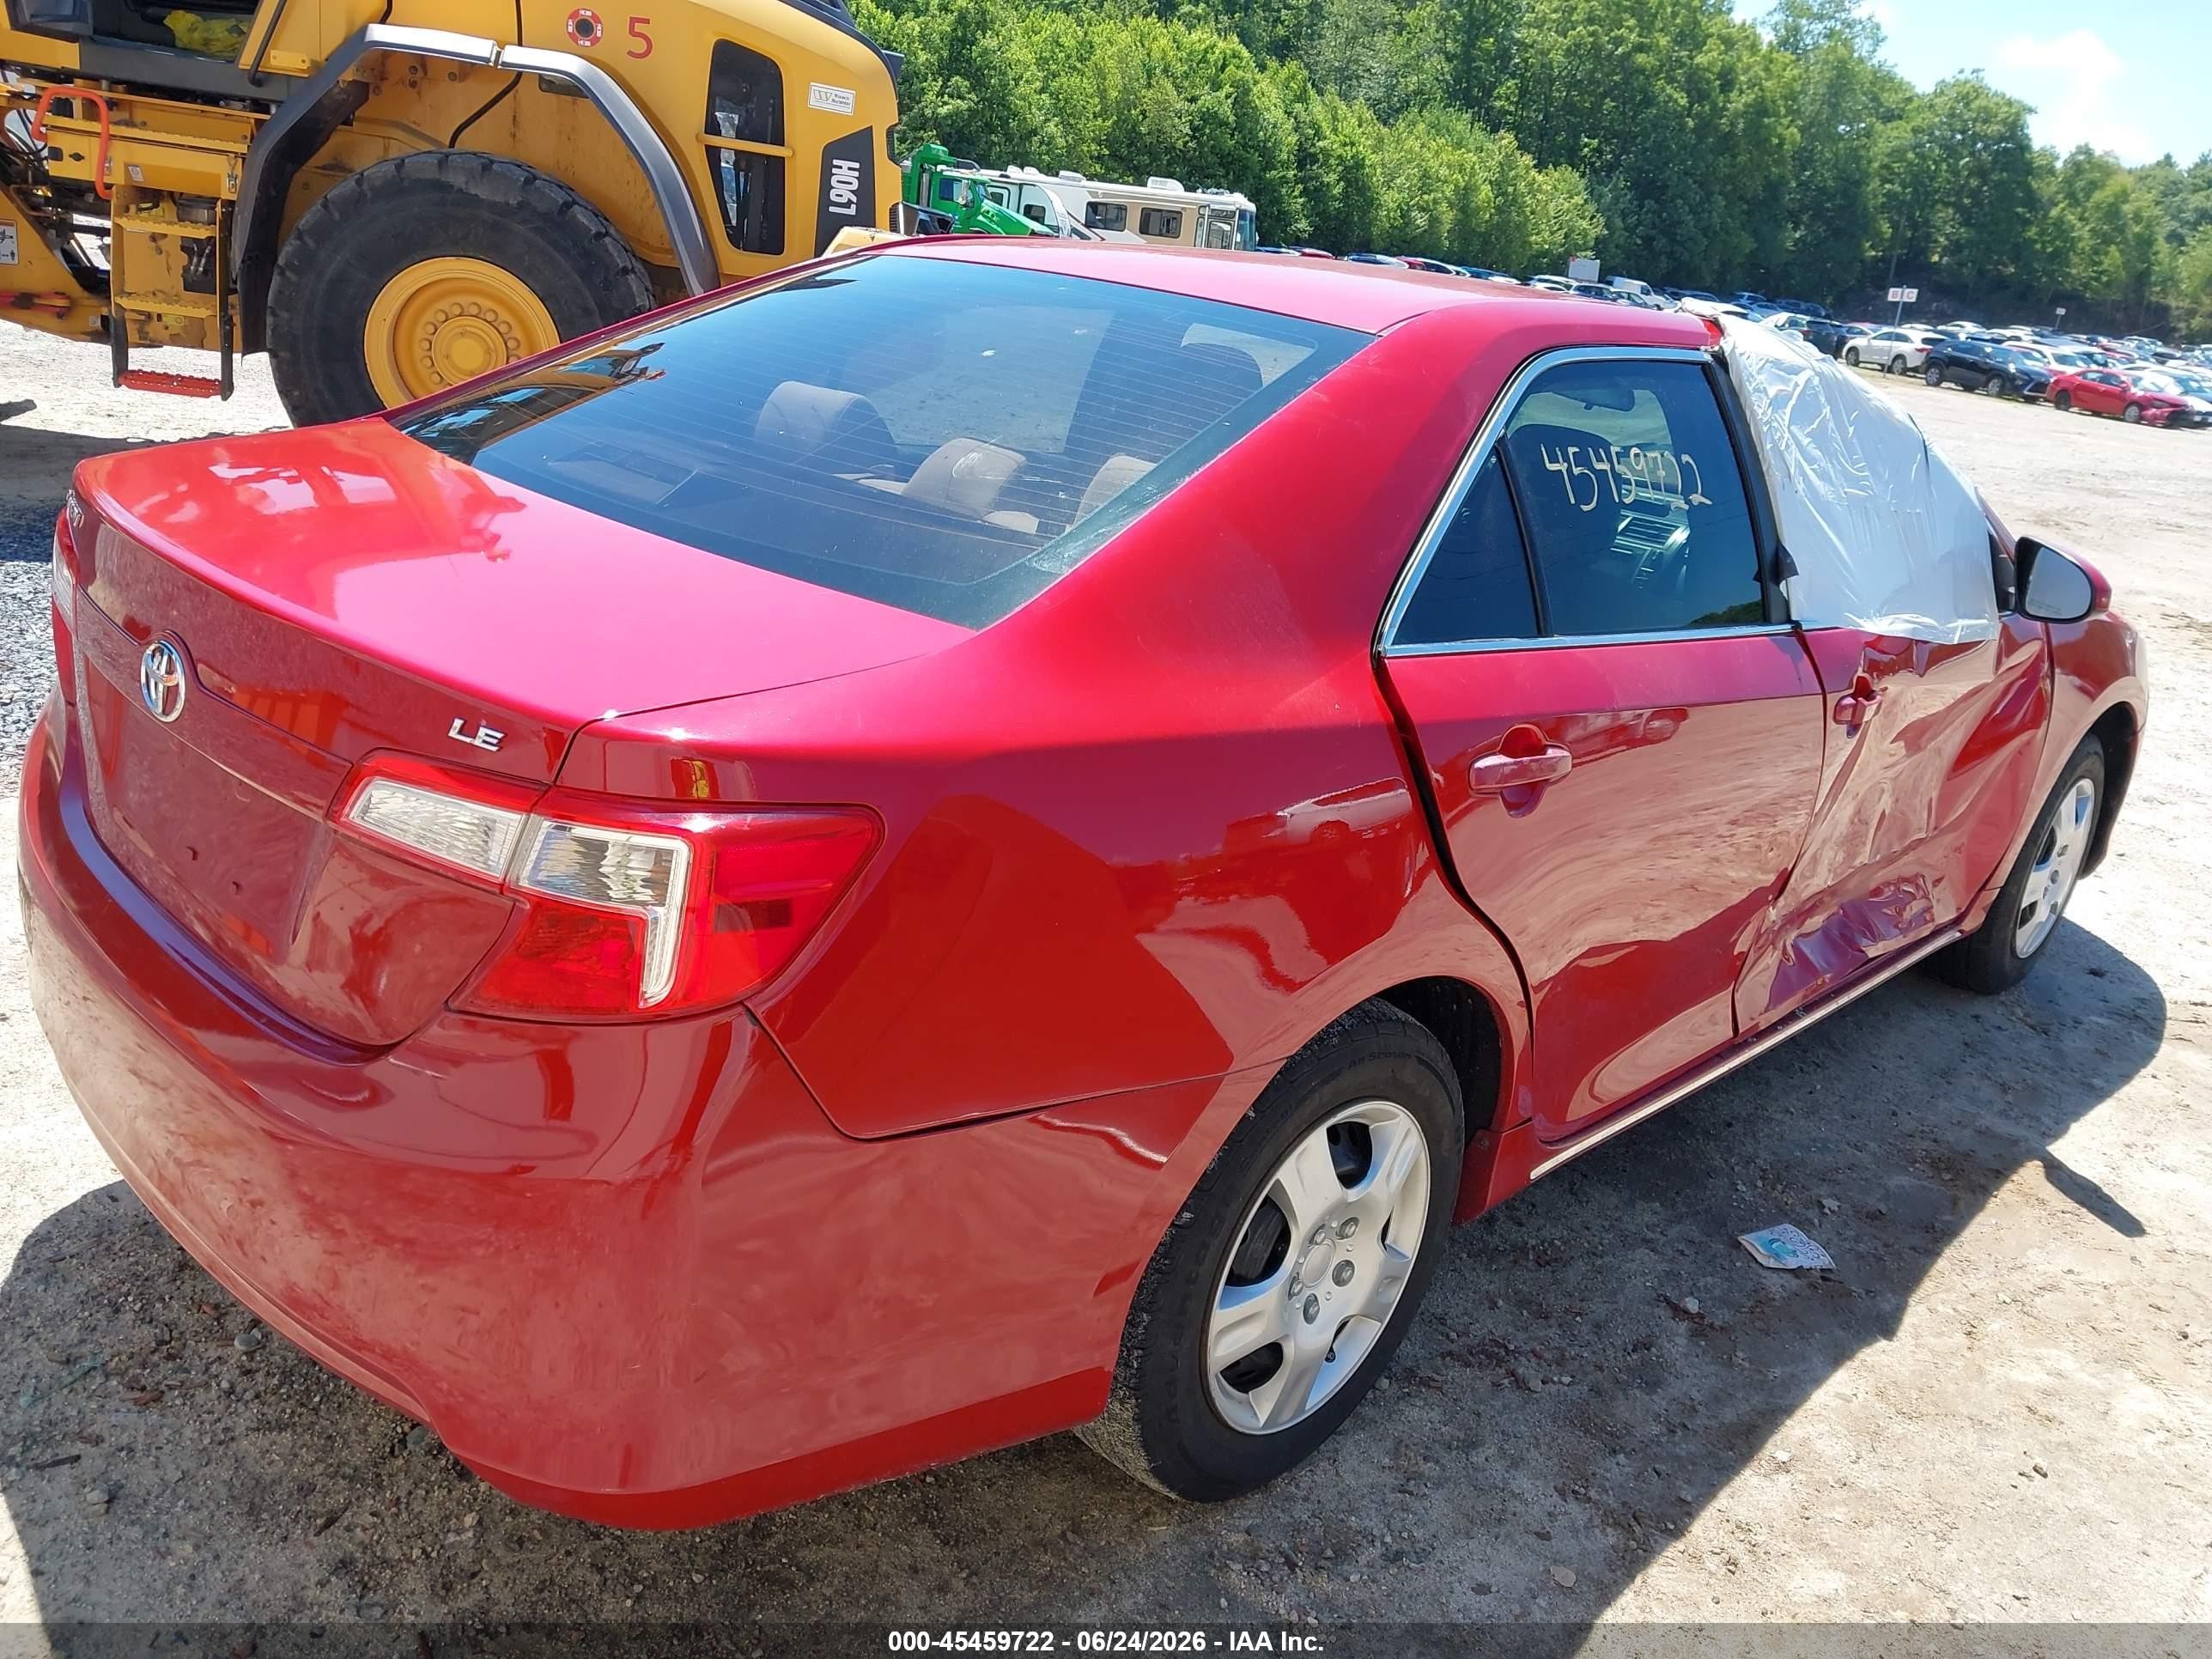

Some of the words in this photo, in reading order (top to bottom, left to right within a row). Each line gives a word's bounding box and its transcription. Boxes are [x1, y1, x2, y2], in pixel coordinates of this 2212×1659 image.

[627, 15, 653, 59] 5
[829, 159, 860, 216] L90H
[1540, 443, 1713, 512] 45459722
[447, 717, 507, 752] LE
